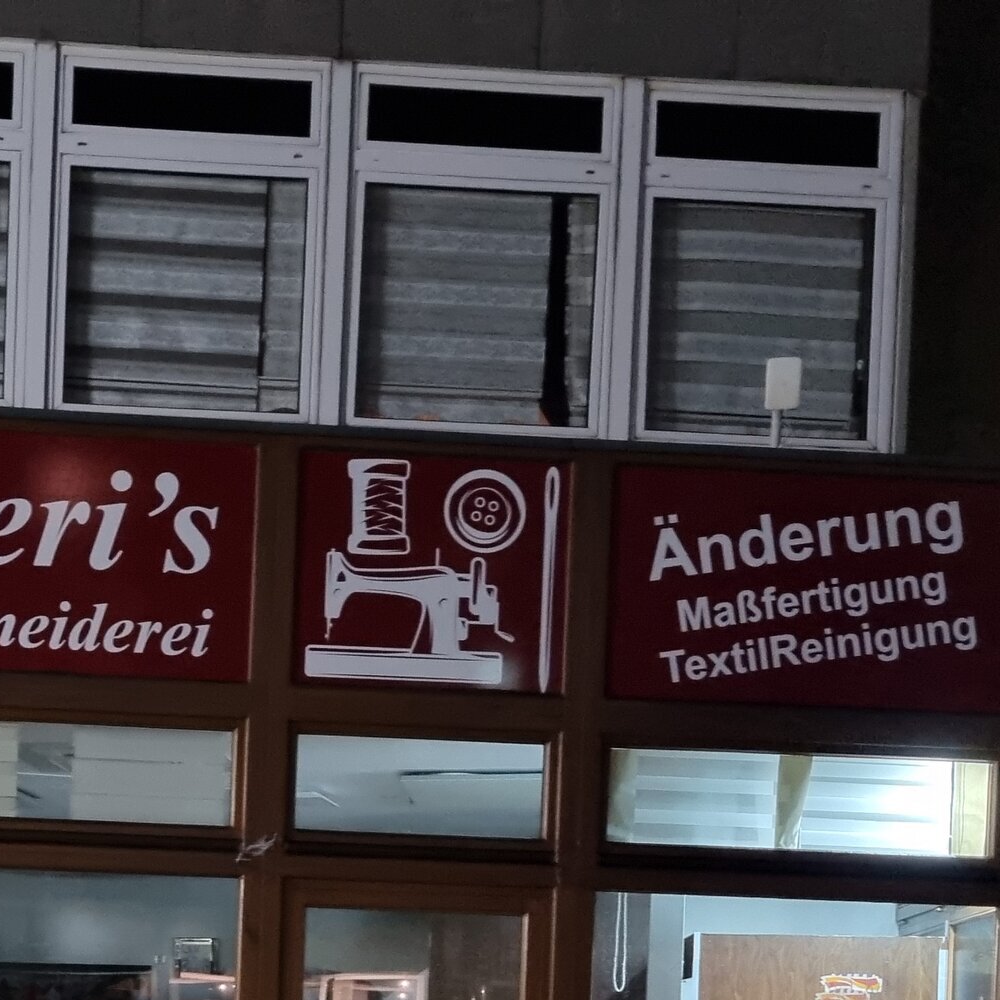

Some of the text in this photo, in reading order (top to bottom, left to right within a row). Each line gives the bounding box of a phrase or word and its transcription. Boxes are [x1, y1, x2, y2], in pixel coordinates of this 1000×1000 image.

[649, 501, 964, 582] Änderung
[677, 571, 948, 632] Maßfertigung
[659, 616, 977, 683] TextilReinigung
